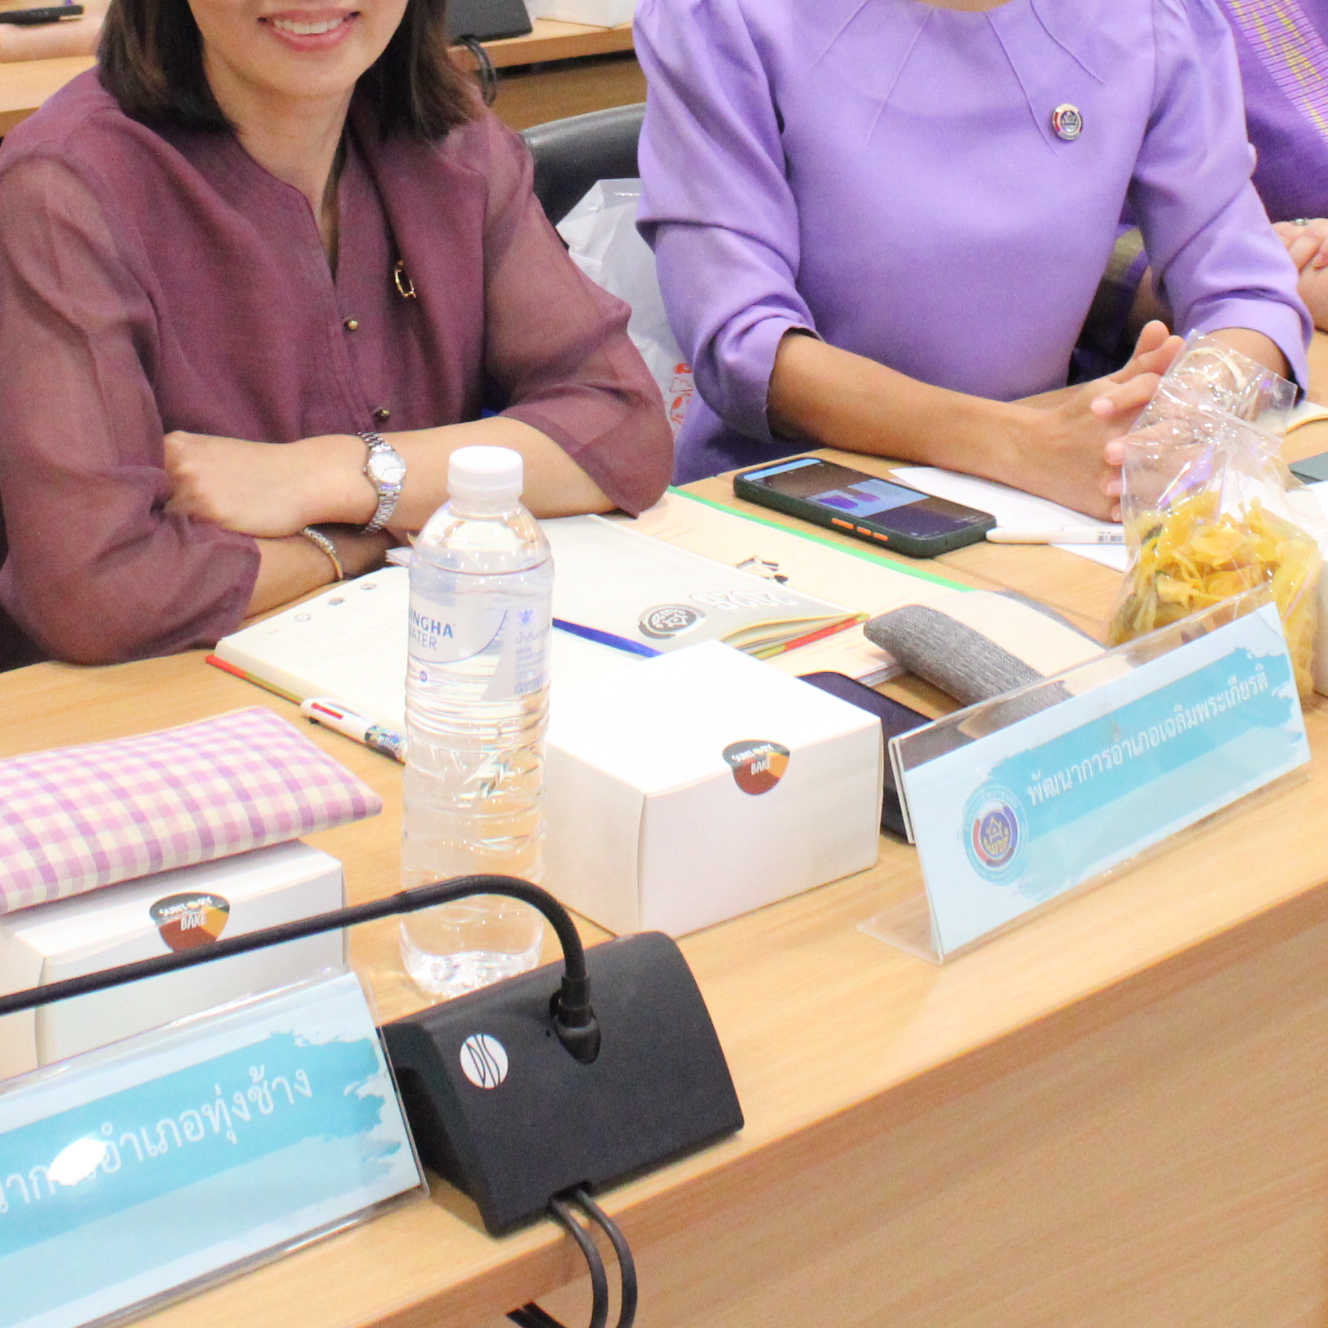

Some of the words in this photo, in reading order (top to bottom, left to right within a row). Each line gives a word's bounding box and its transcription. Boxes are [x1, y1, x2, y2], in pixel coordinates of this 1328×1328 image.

[1026, 663, 1269, 807] พัฒนาการอำเภอเฉลิมพระเกียรติ
